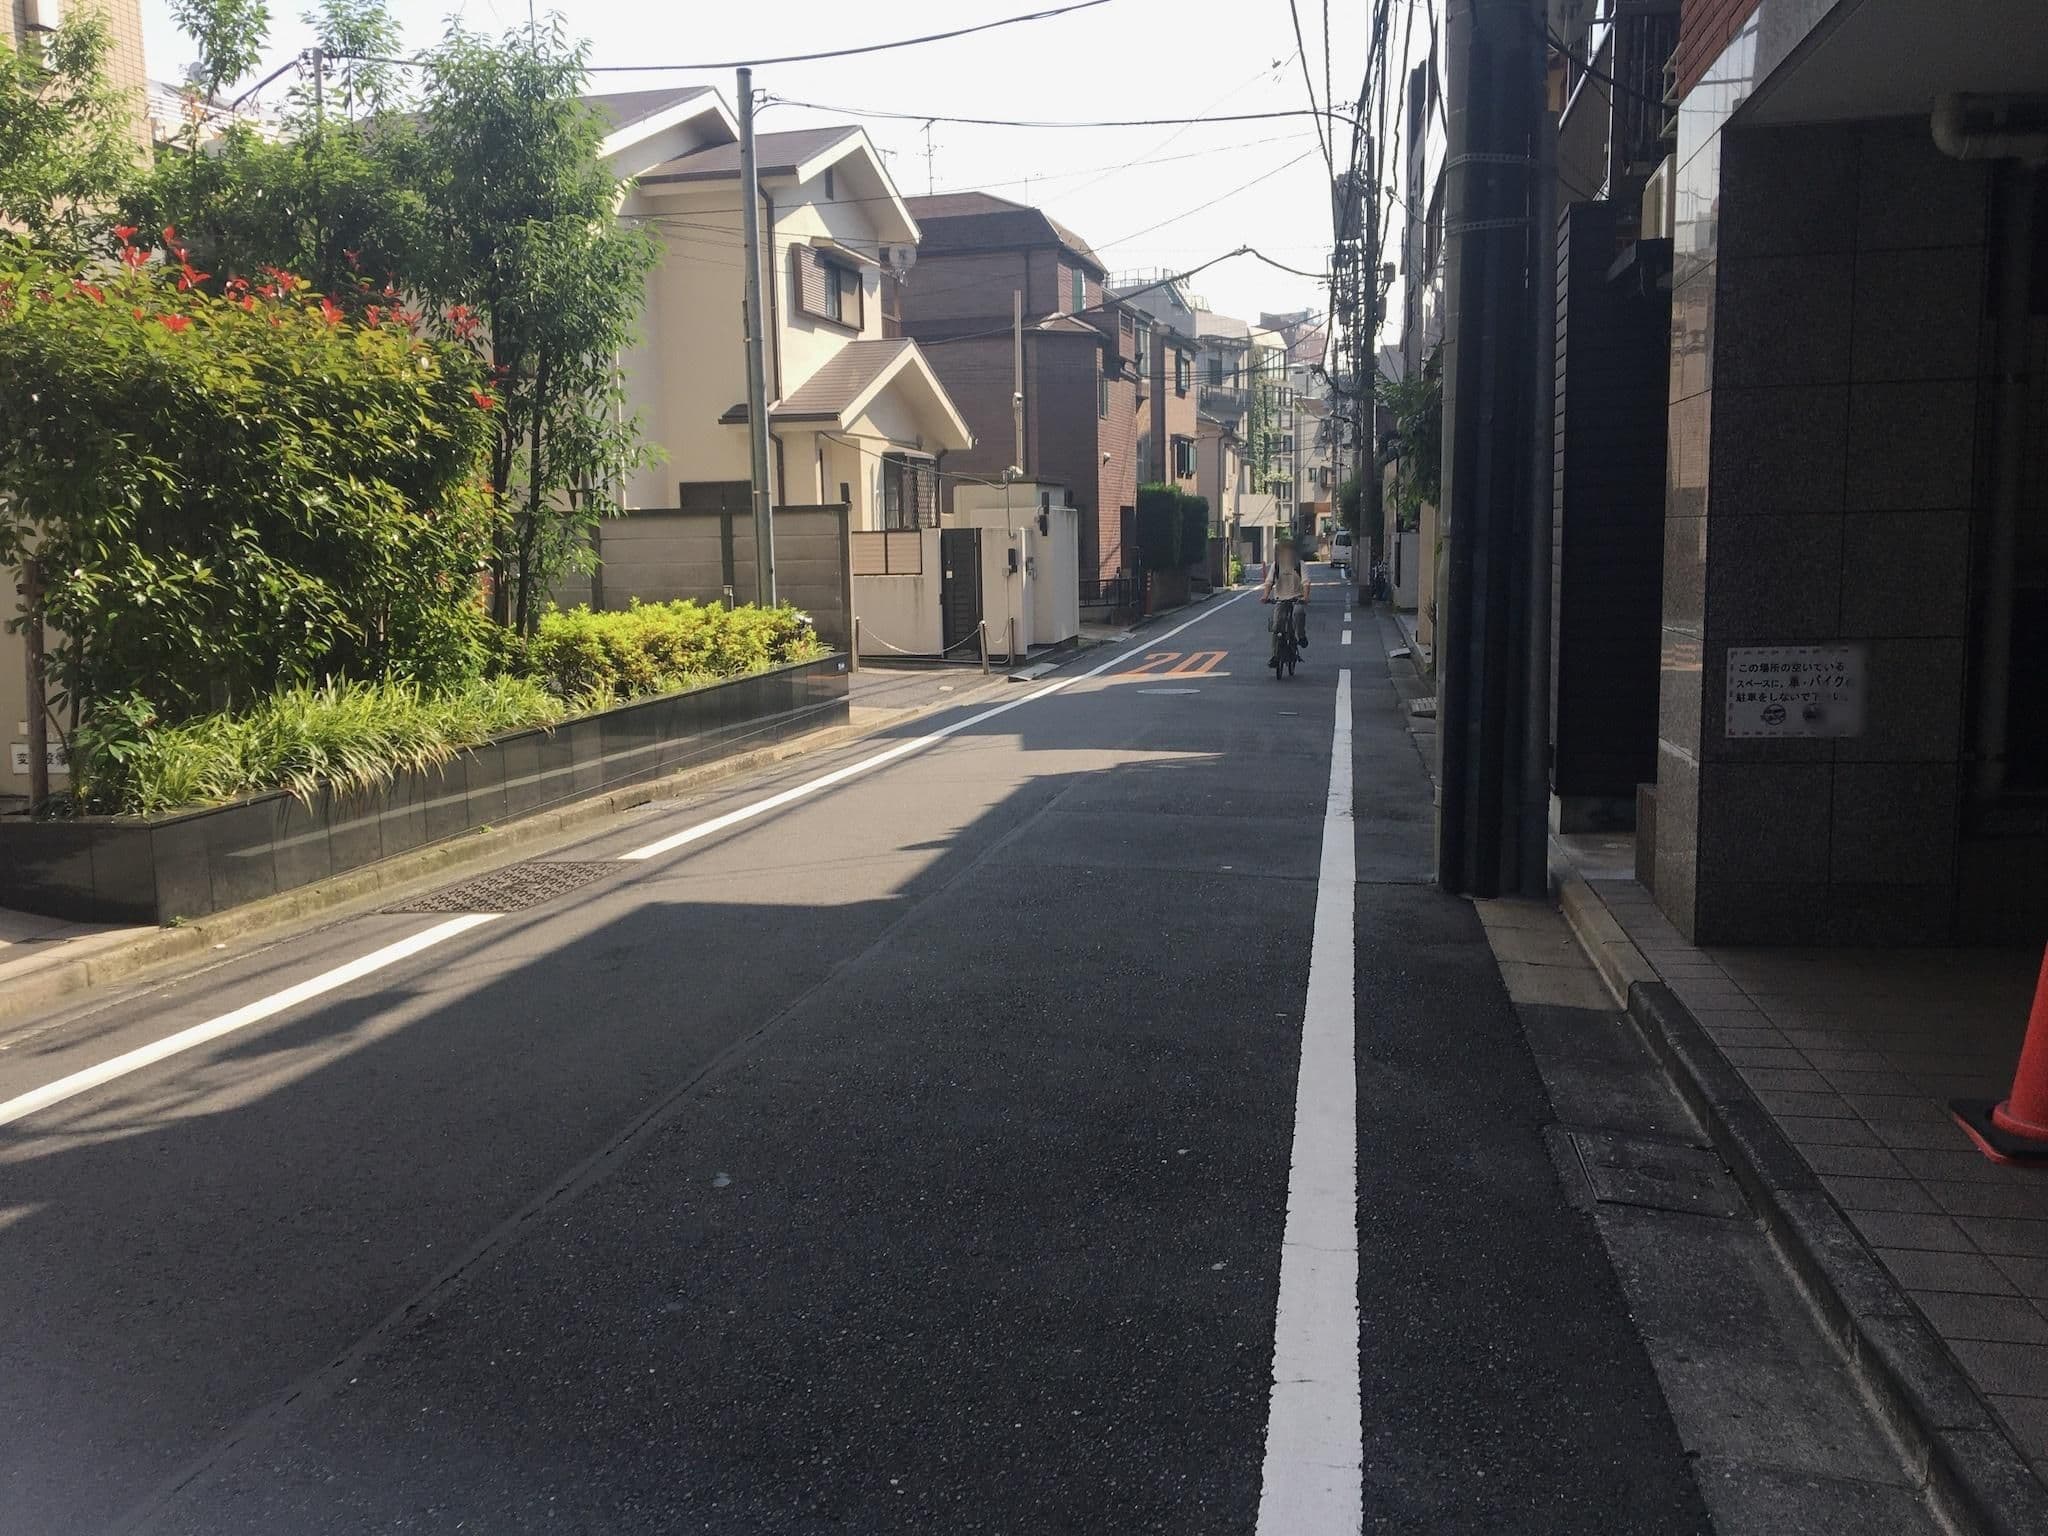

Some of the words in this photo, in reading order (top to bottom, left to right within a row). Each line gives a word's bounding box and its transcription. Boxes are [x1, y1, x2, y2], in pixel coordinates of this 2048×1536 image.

[1108, 651, 1229, 680] 20
[1738, 662, 1845, 673] この場所の空いている
